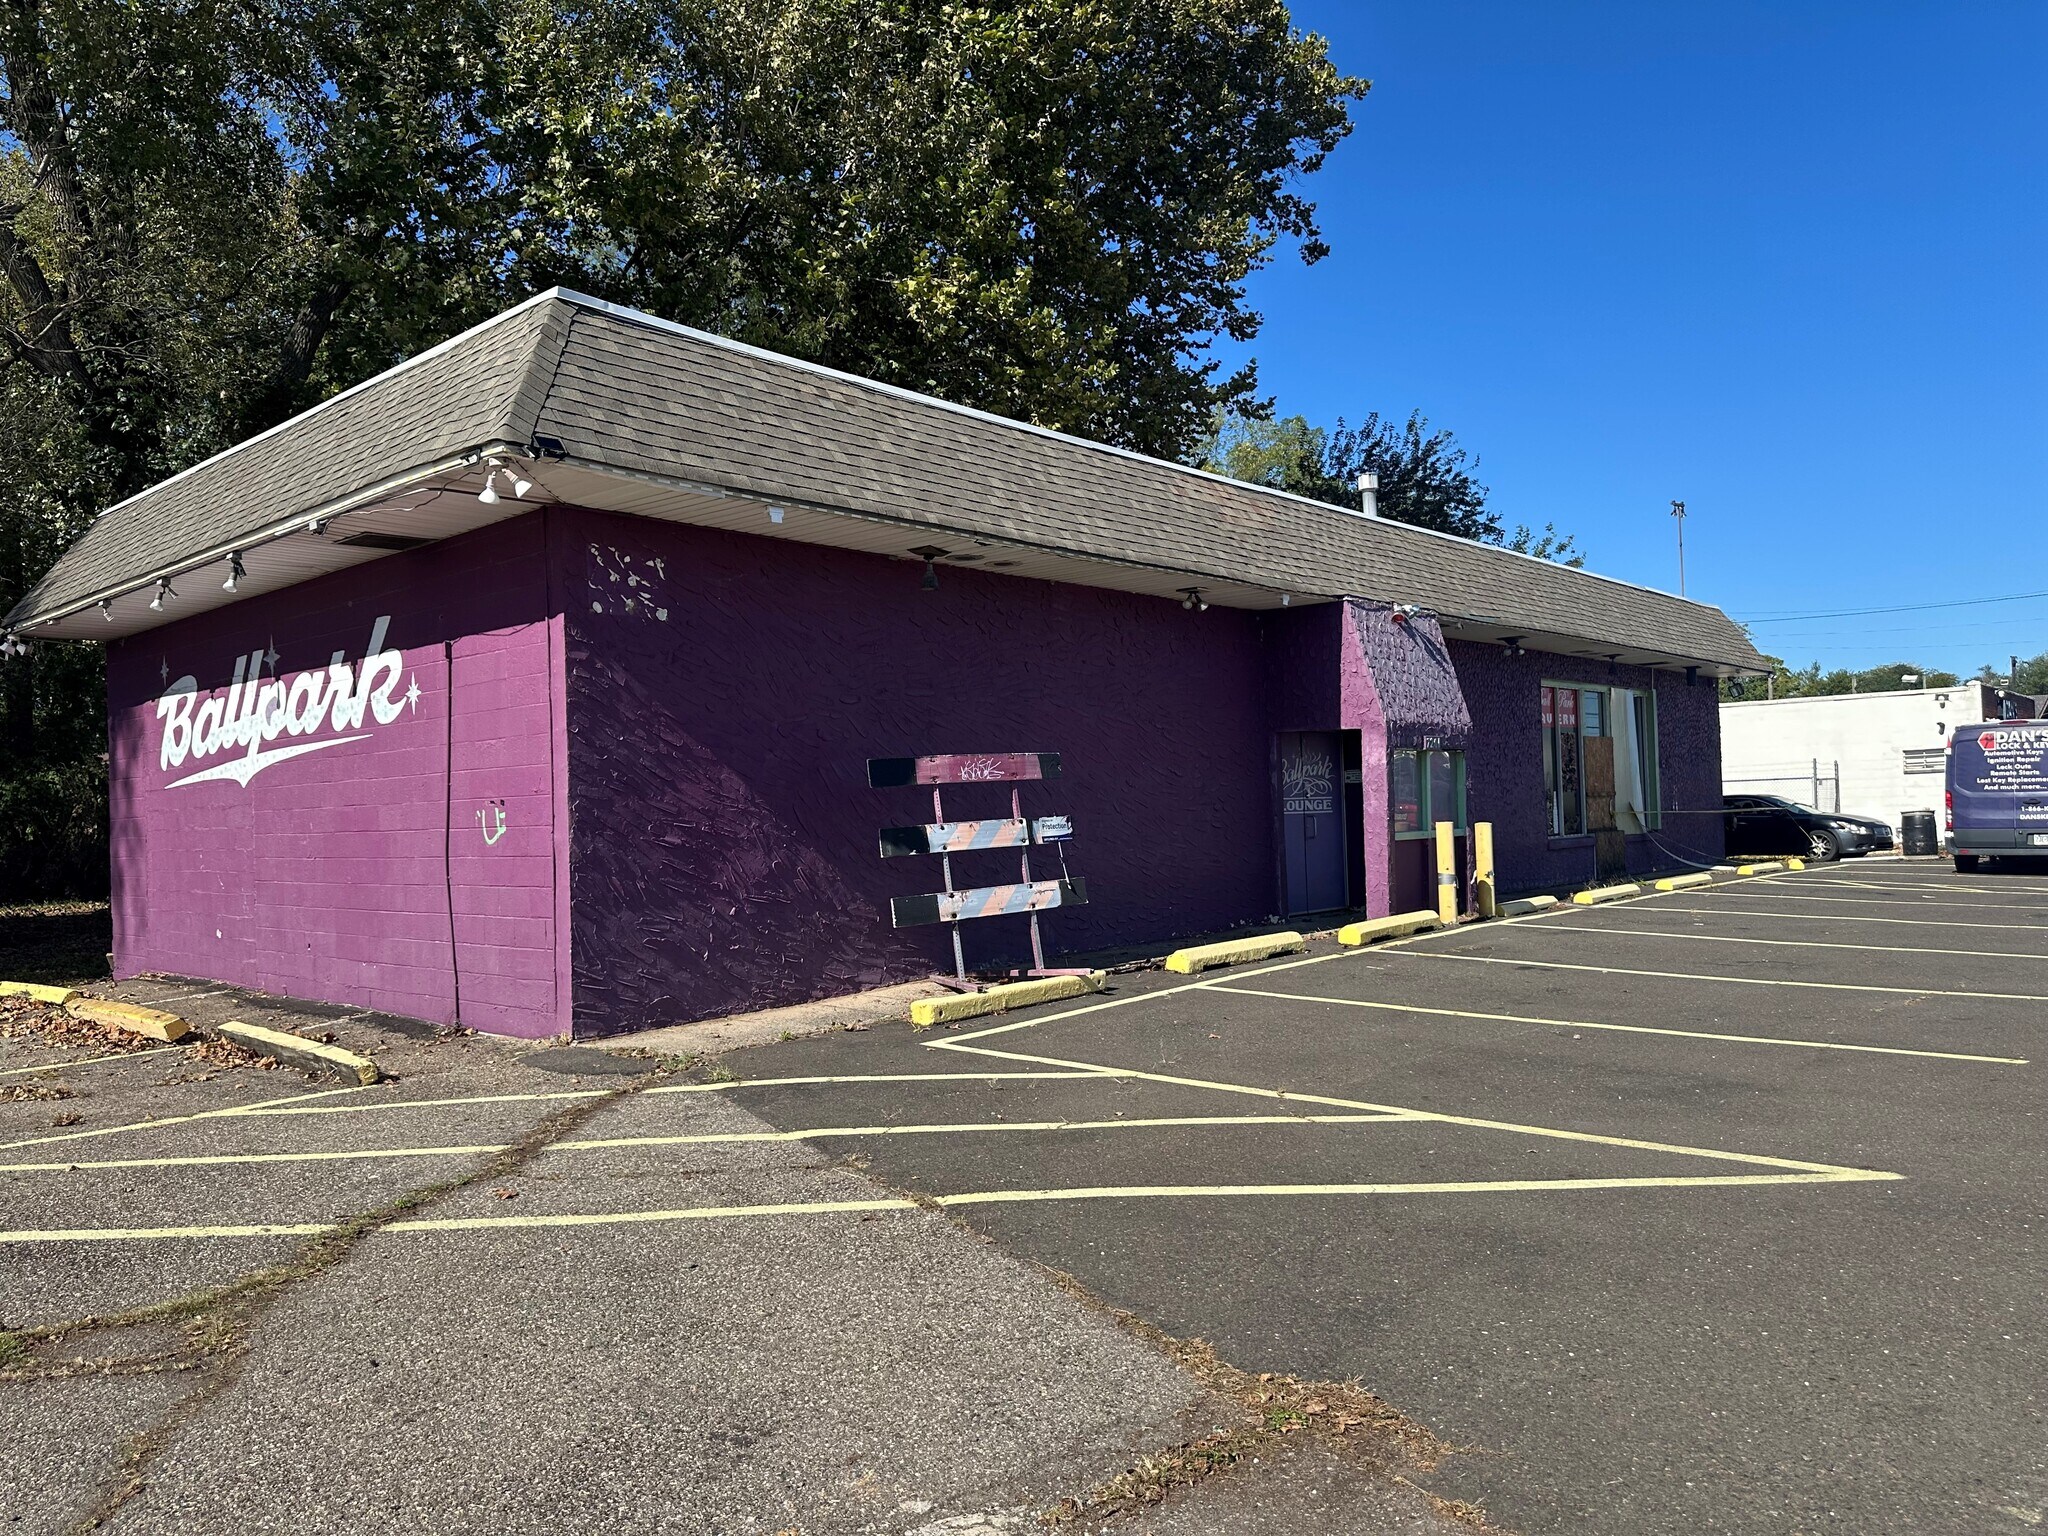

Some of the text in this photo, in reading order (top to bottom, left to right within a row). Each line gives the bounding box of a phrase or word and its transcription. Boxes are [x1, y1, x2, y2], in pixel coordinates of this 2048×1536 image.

[157, 615, 408, 772] Ballpark
[1996, 730, 2048, 742] DAN'S
[1996, 742, 2021, 750] LOCK
[1284, 799, 1332, 811] OUNGE
